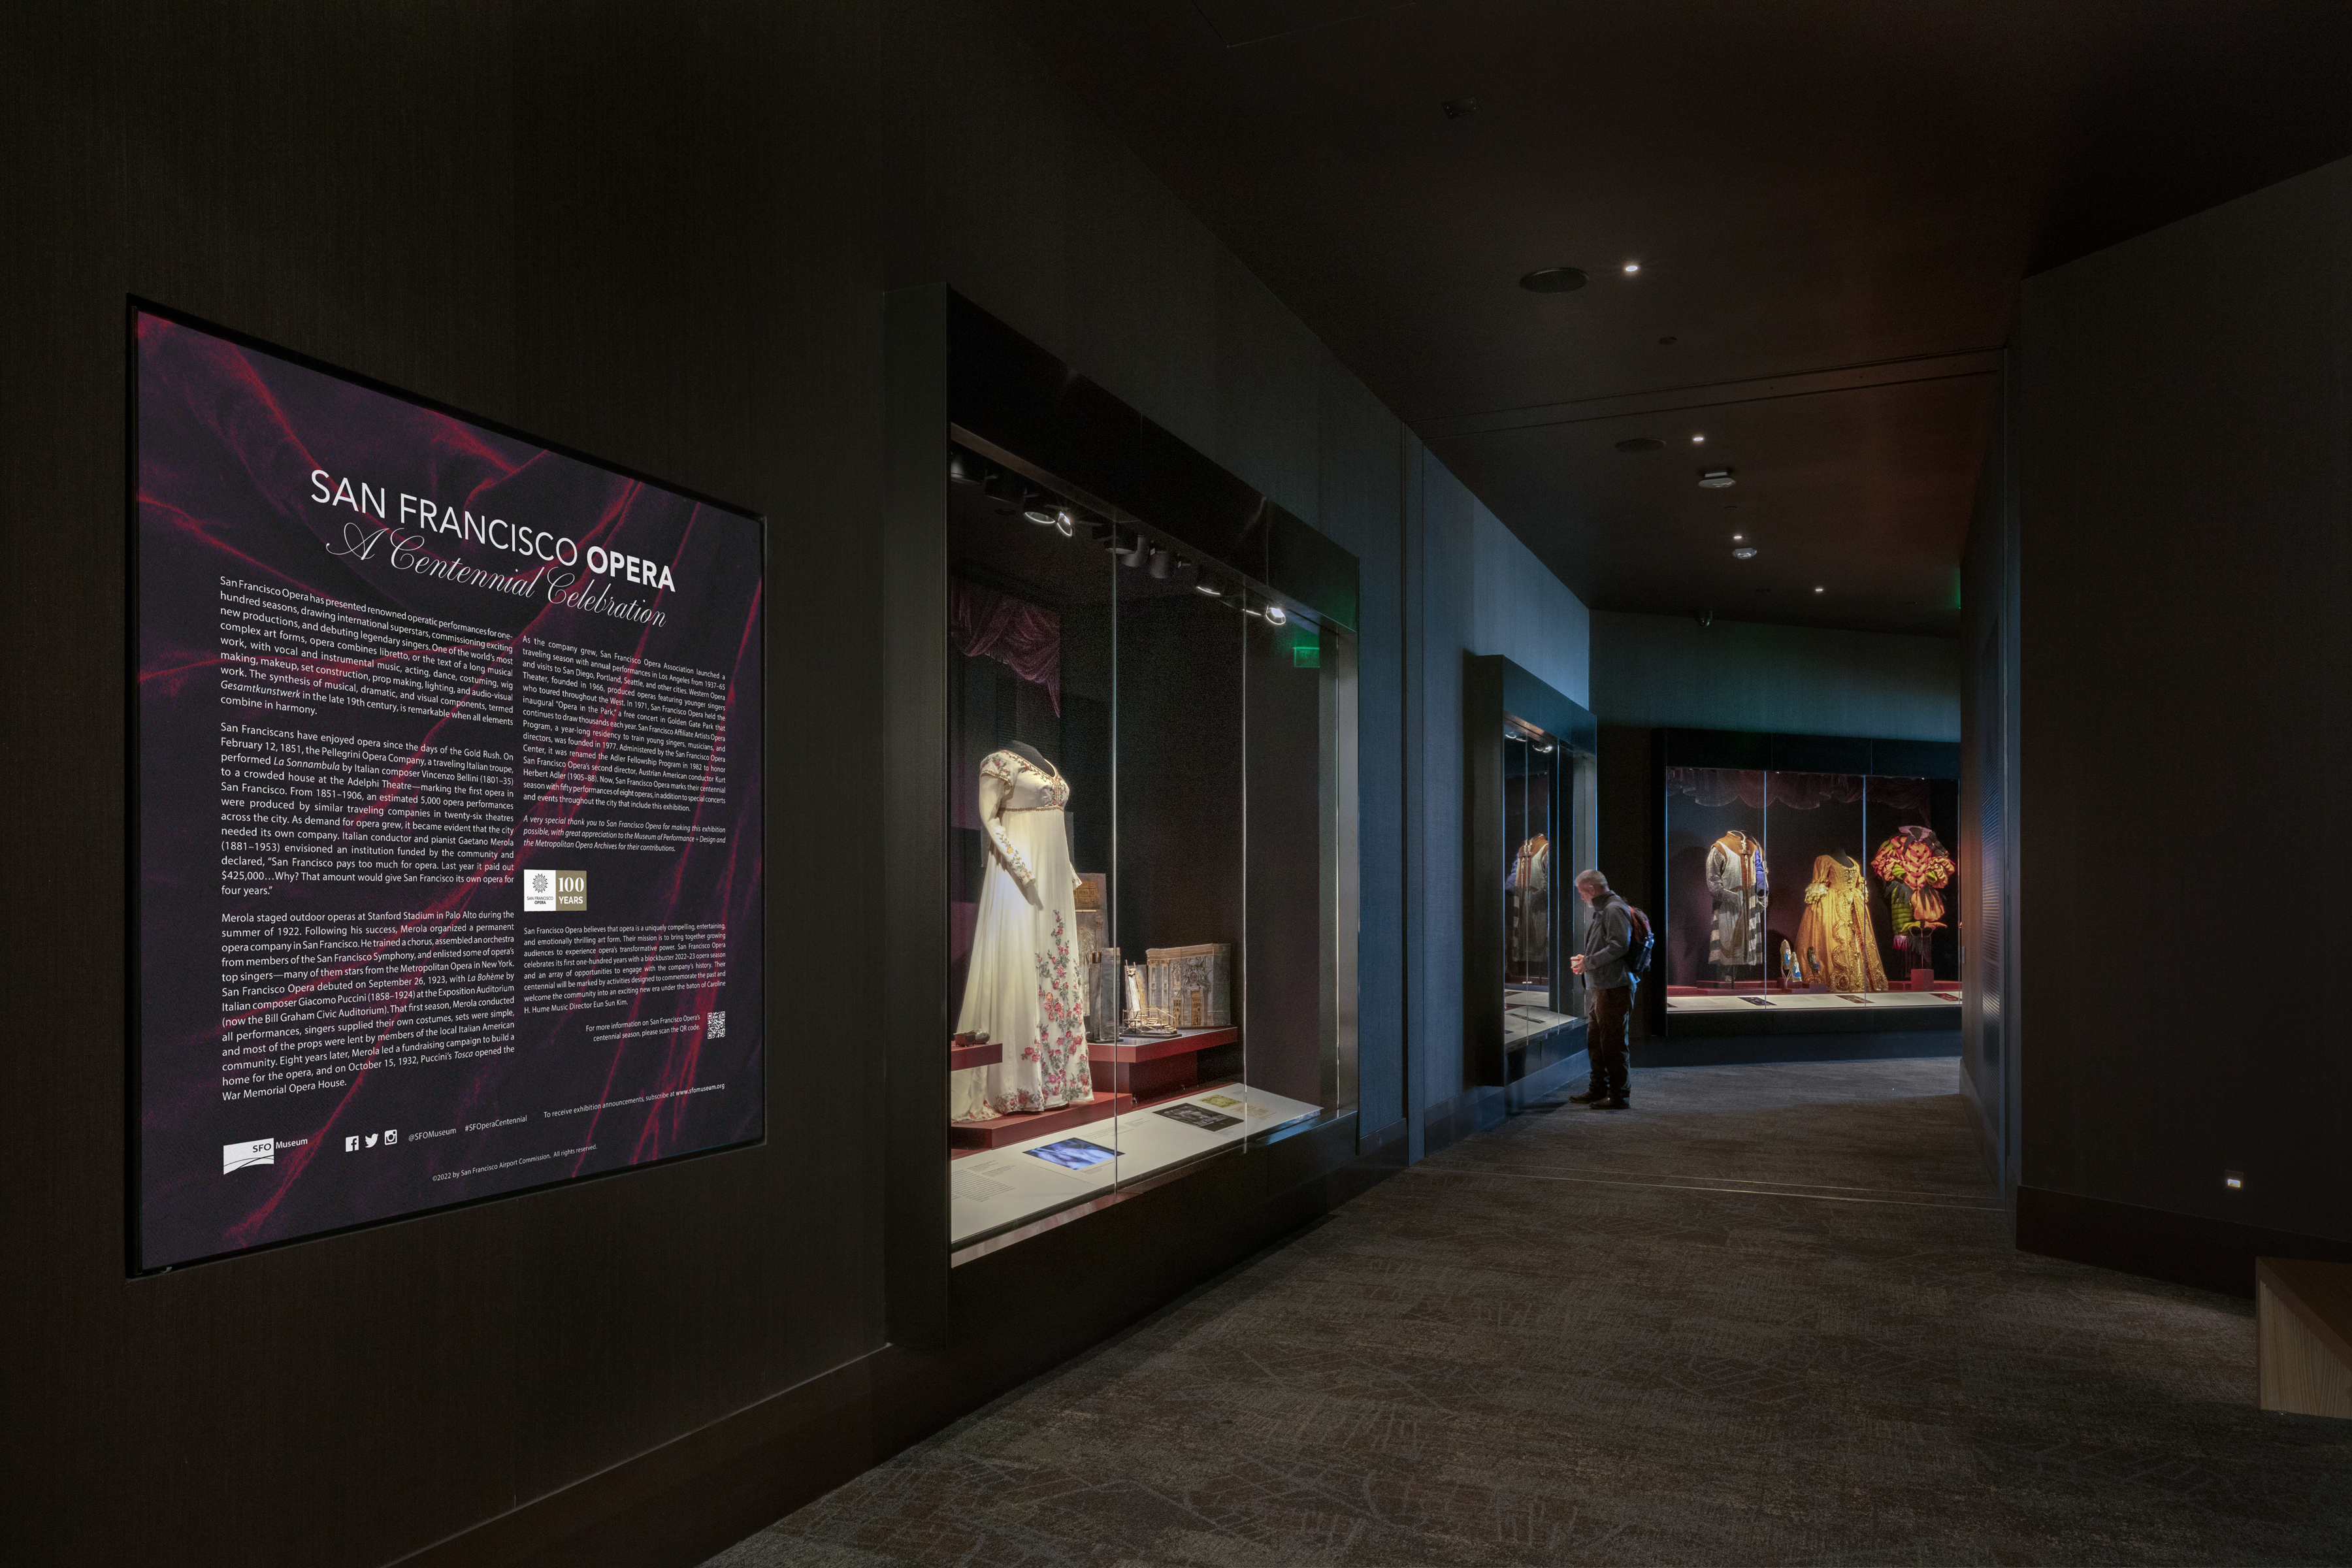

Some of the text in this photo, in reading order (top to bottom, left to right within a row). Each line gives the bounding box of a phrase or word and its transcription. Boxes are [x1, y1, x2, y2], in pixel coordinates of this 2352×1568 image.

[310, 469, 676, 593] SAN FRANCISCO OPERA
[325, 522, 667, 628] A Centennial Celebration
[220, 576, 513, 640] San Francisco Opera has presented renowned operatic performances for one-
[220, 589, 513, 655] hundred seasons, drawing international superstars, commissioning exciting
[522, 634, 531, 644] As
[533, 637, 546, 647] the
[548, 642, 578, 654] company
[580, 647, 598, 657] grew,
[600, 649, 612, 659] San
[614, 652, 642, 664] Francisco
[644, 658, 661, 668] Opera
[663, 662, 694, 674] Association
[696, 668, 720, 679] launched
[522, 671, 549, 683] Theater,
[551, 675, 578, 687] founded
[589, 682, 605, 693] 1966,
[607, 687, 635, 696] produced
[636, 691, 657, 700] operas
[657, 693, 683, 706] featuring
[684, 699, 706, 709] younger
[707, 702, 726, 711] singers
[220, 696, 318, 716] combine in harmony.
[220, 798, 514, 822] were produced by similar traveling companies in twenty-six theatres
[523, 792, 536, 801] and
[559, 794, 595, 806] throughout
[595, 797, 606, 806] the
[606, 799, 617, 808] city
[618, 799, 630, 808] that
[630, 800, 651, 809] include
[662, 803, 691, 811] exhibition.
[523, 838, 534, 847] the
[534, 839, 574, 849] Metropolitan
[575, 840, 593, 850] Opera
[593, 841, 617, 850] Archives
[618, 841, 627, 850] for
[640, 843, 676, 852] contributions.
[221, 885, 272, 897] four years.”
[558, 877, 585, 892] 100
[559, 896, 583, 904] YEARS
[221, 929, 261, 938] summer
[264, 926, 274, 936] of
[278, 926, 302, 936] 1922.
[305, 926, 347, 936] Following
[350, 925, 363, 934] his
[400, 924, 427, 933] Merola
[429, 923, 466, 934] organized
[476, 923, 514, 933] permanent
[523, 949, 555, 957] audiences
[564, 947, 596, 956] experience
[598, 945, 618, 955] opera’s
[221, 1031, 233, 1041] all
[236, 1028, 302, 1043] performances,
[304, 1025, 335, 1036] singers
[338, 1019, 373, 1032] supplied
[375, 1019, 395, 1028] their
[396, 1018, 414, 1026] own
[416, 1015, 453, 1024] costumes,
[455, 1013, 470, 1021] sets
[490, 1008, 515, 1019] simple,
[611, 1020, 642, 1029] information
[683, 1013, 700, 1022] Opera’s
[593, 1032, 621, 1042] centennial
[642, 1029, 659, 1037] please
[221, 1079, 347, 1101] War Memorial Opera House.
[551, 1108, 572, 1117] receive
[573, 1103, 601, 1113] exhibition
[602, 1096, 645, 1109] announcements,
[645, 1092, 669, 1101] subscribe
[675, 1083, 725, 1096] www.sfomuseum.org
[465, 1114, 527, 1132] #SFOperaCentennial
[408, 1128, 457, 1142] @SFOMuseum
[252, 1138, 308, 1153] SFO Museum
[432, 1172, 451, 1181] ©2022
[472, 1164, 498, 1173] Francisco
[498, 1159, 518, 1169] Airport
[518, 1154, 551, 1164] Commission.
[561, 1149, 576, 1157] rights
[576, 1143, 597, 1153] reserved.
